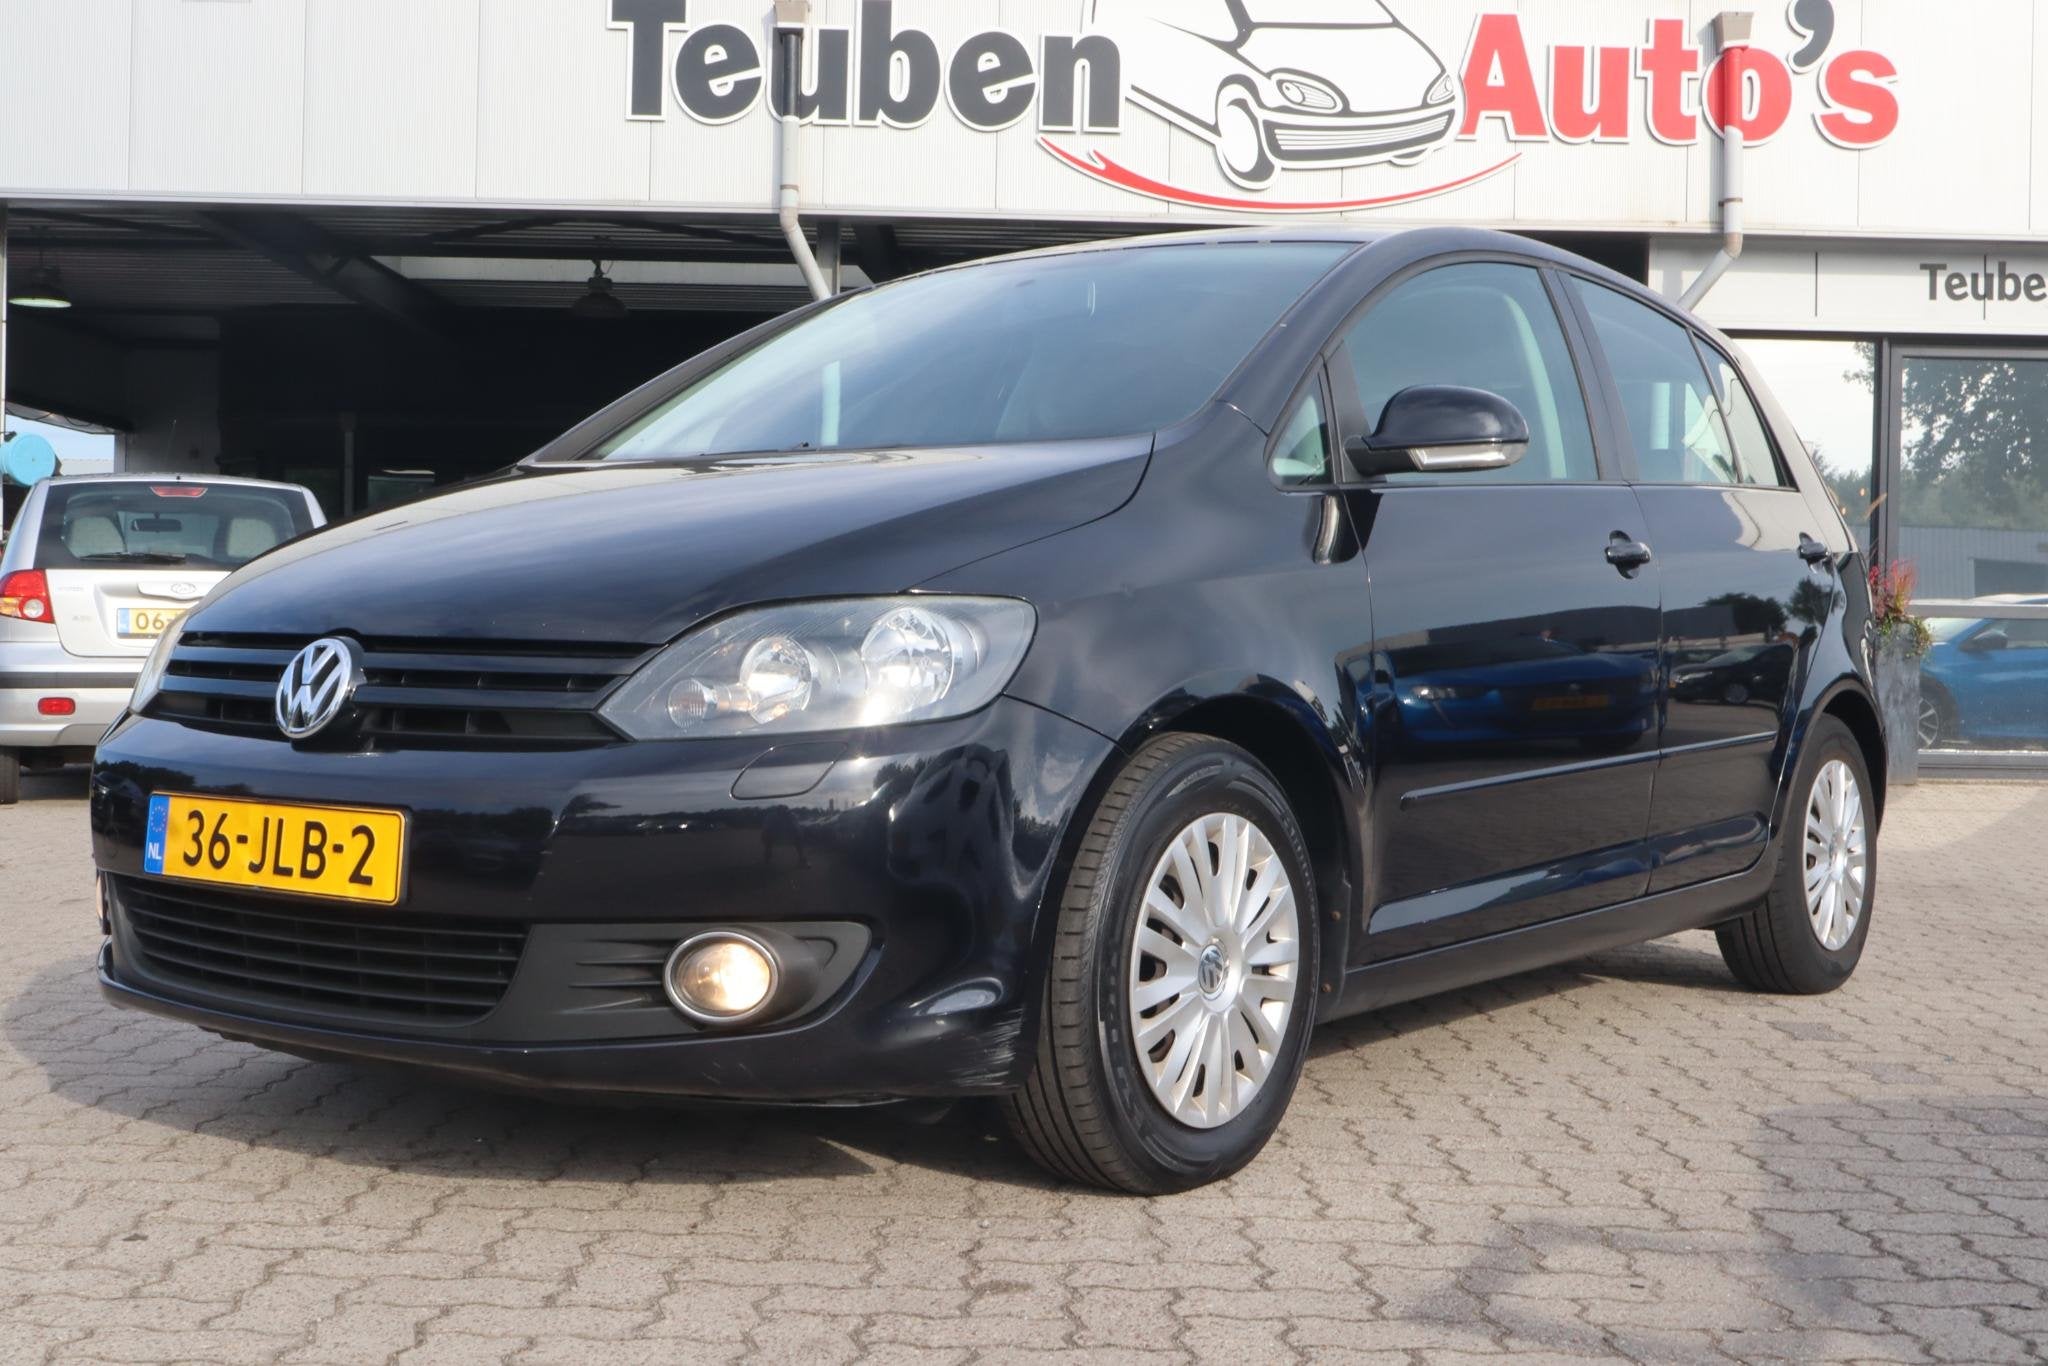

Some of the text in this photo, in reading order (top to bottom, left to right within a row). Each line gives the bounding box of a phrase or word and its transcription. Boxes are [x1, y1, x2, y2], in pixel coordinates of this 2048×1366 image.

[610, 0, 1900, 144] Teuben Auto's
[1920, 261, 2048, 302] Teube
[148, 842, 162, 860] NL
[183, 810, 375, 886] 36-JLB-2
